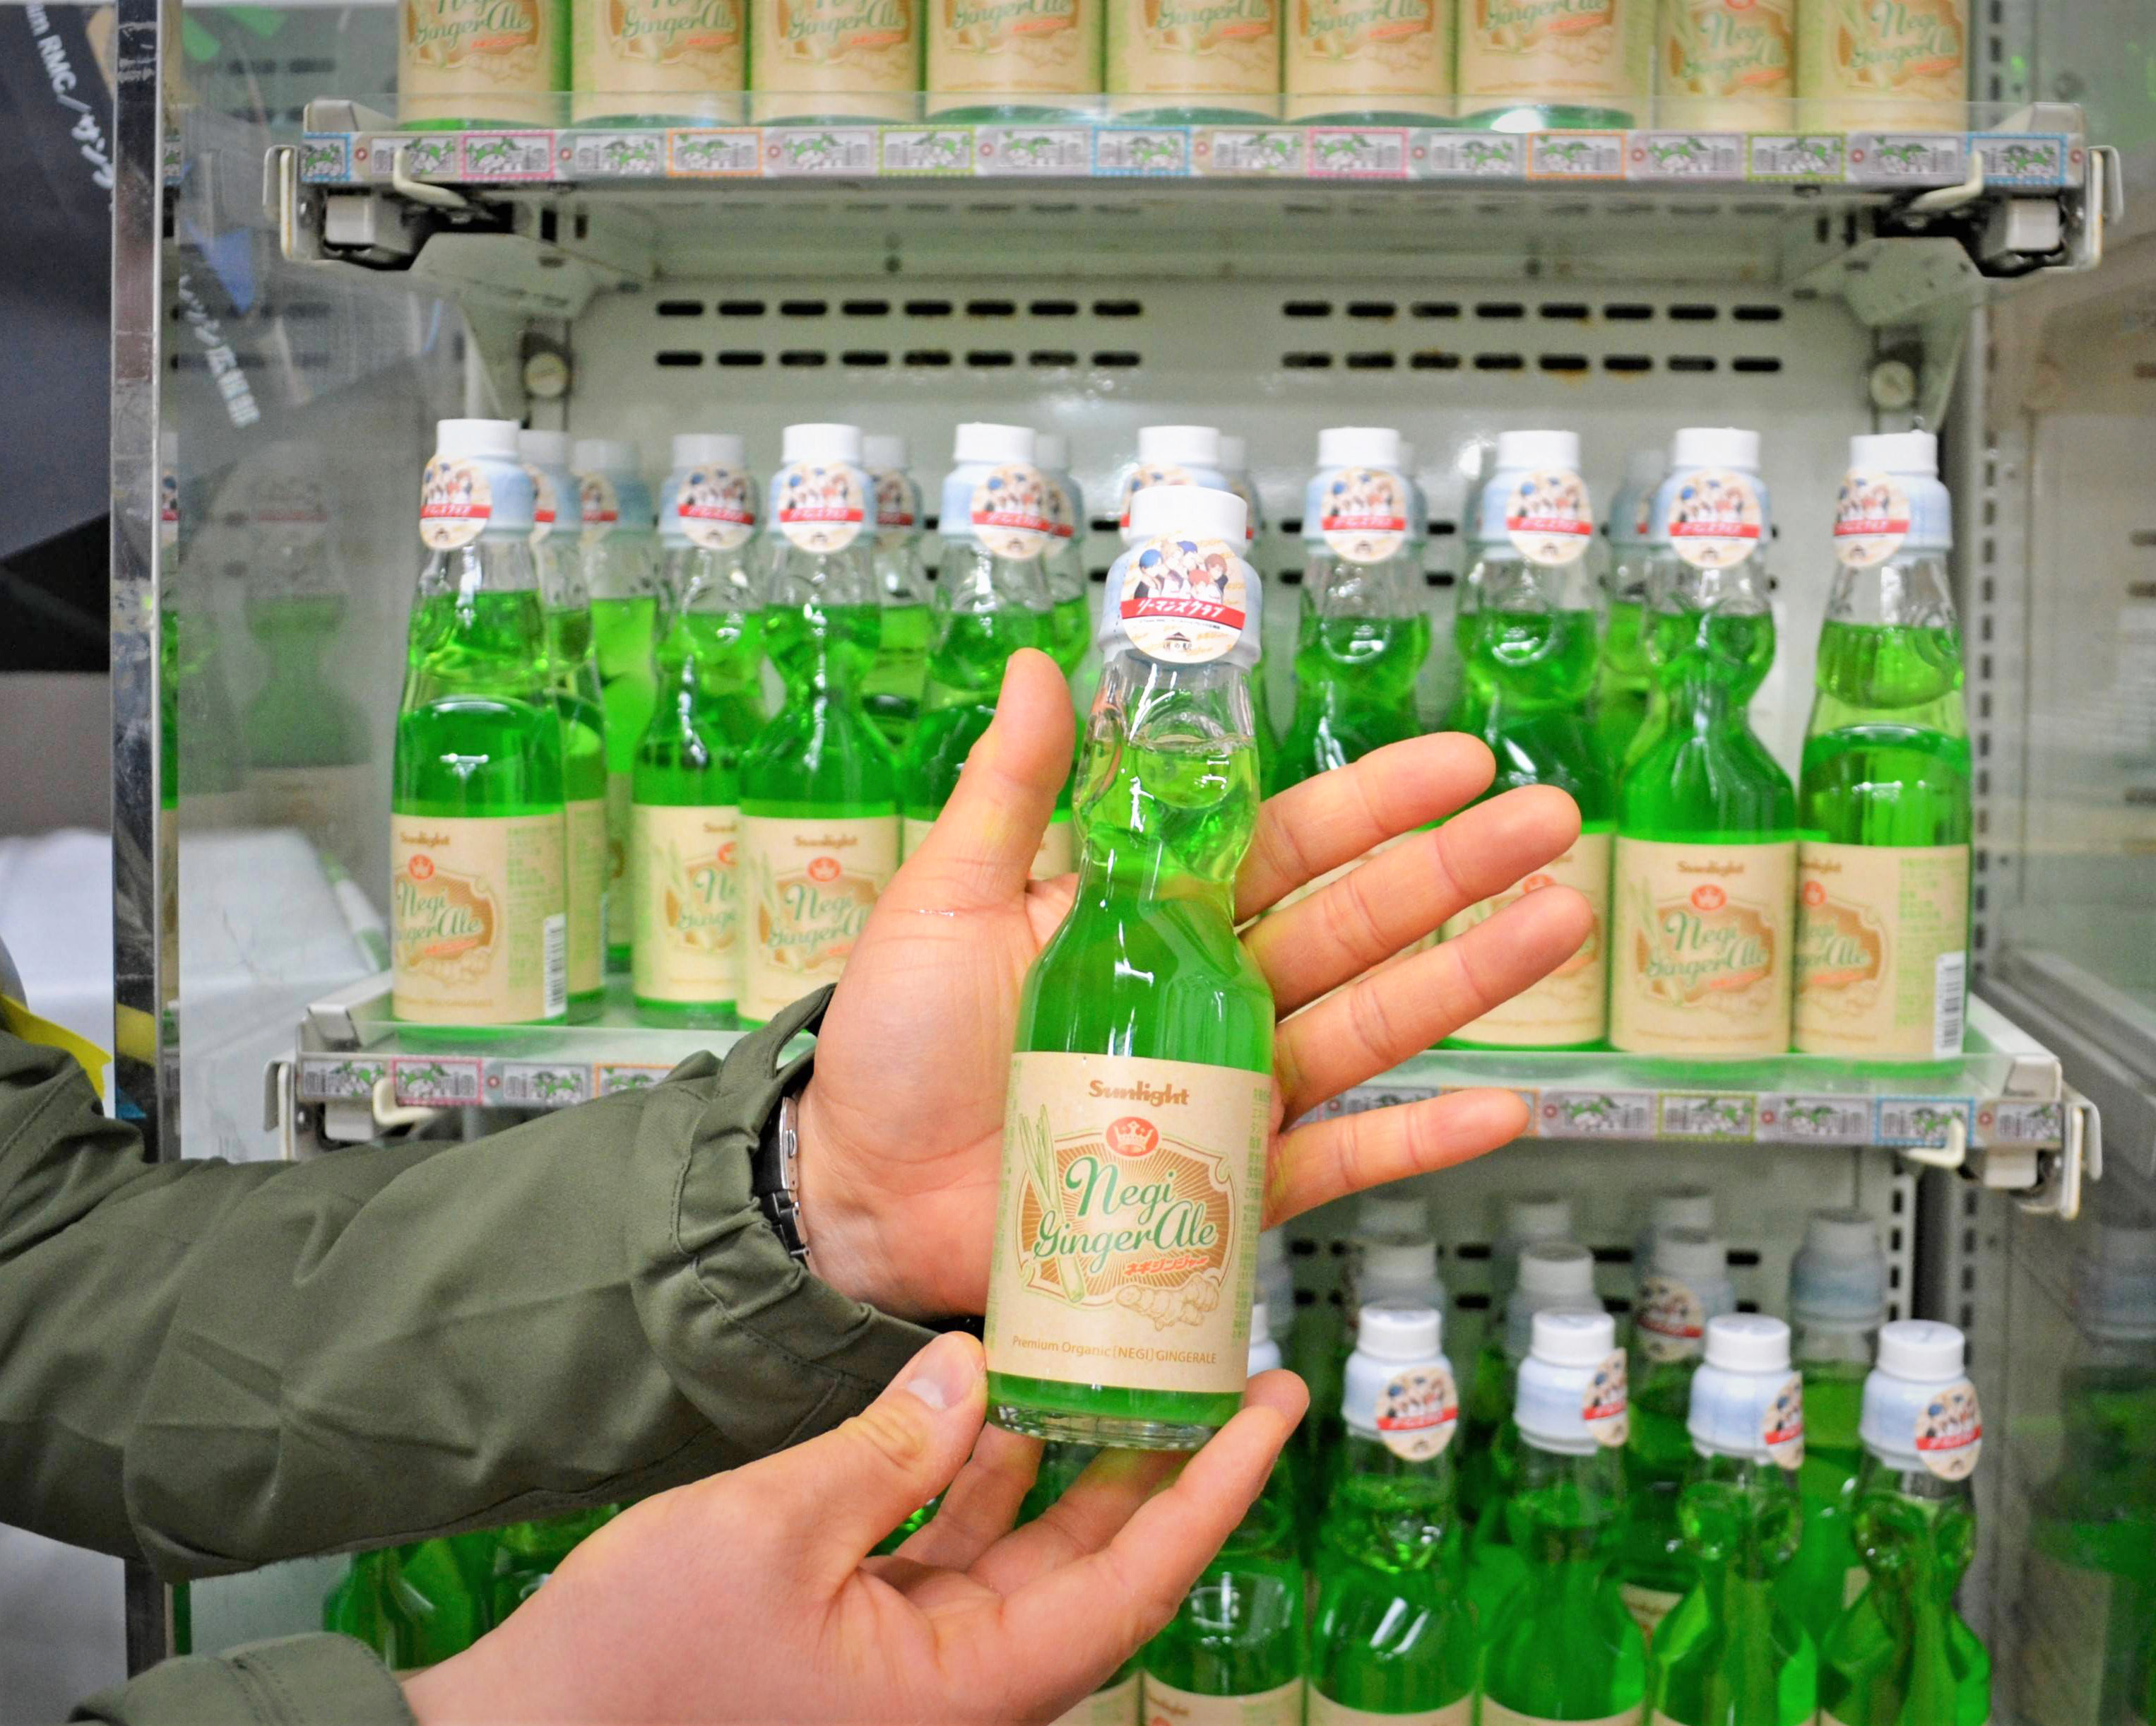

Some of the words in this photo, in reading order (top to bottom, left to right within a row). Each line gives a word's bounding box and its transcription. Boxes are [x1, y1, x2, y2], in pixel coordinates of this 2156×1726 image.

[1089, 1080, 1190, 1107] Sunlight
[1065, 1156, 1175, 1225] Negi
[1012, 1335, 1059, 1352] Premium
[1062, 1342, 1110, 1357] Organic
